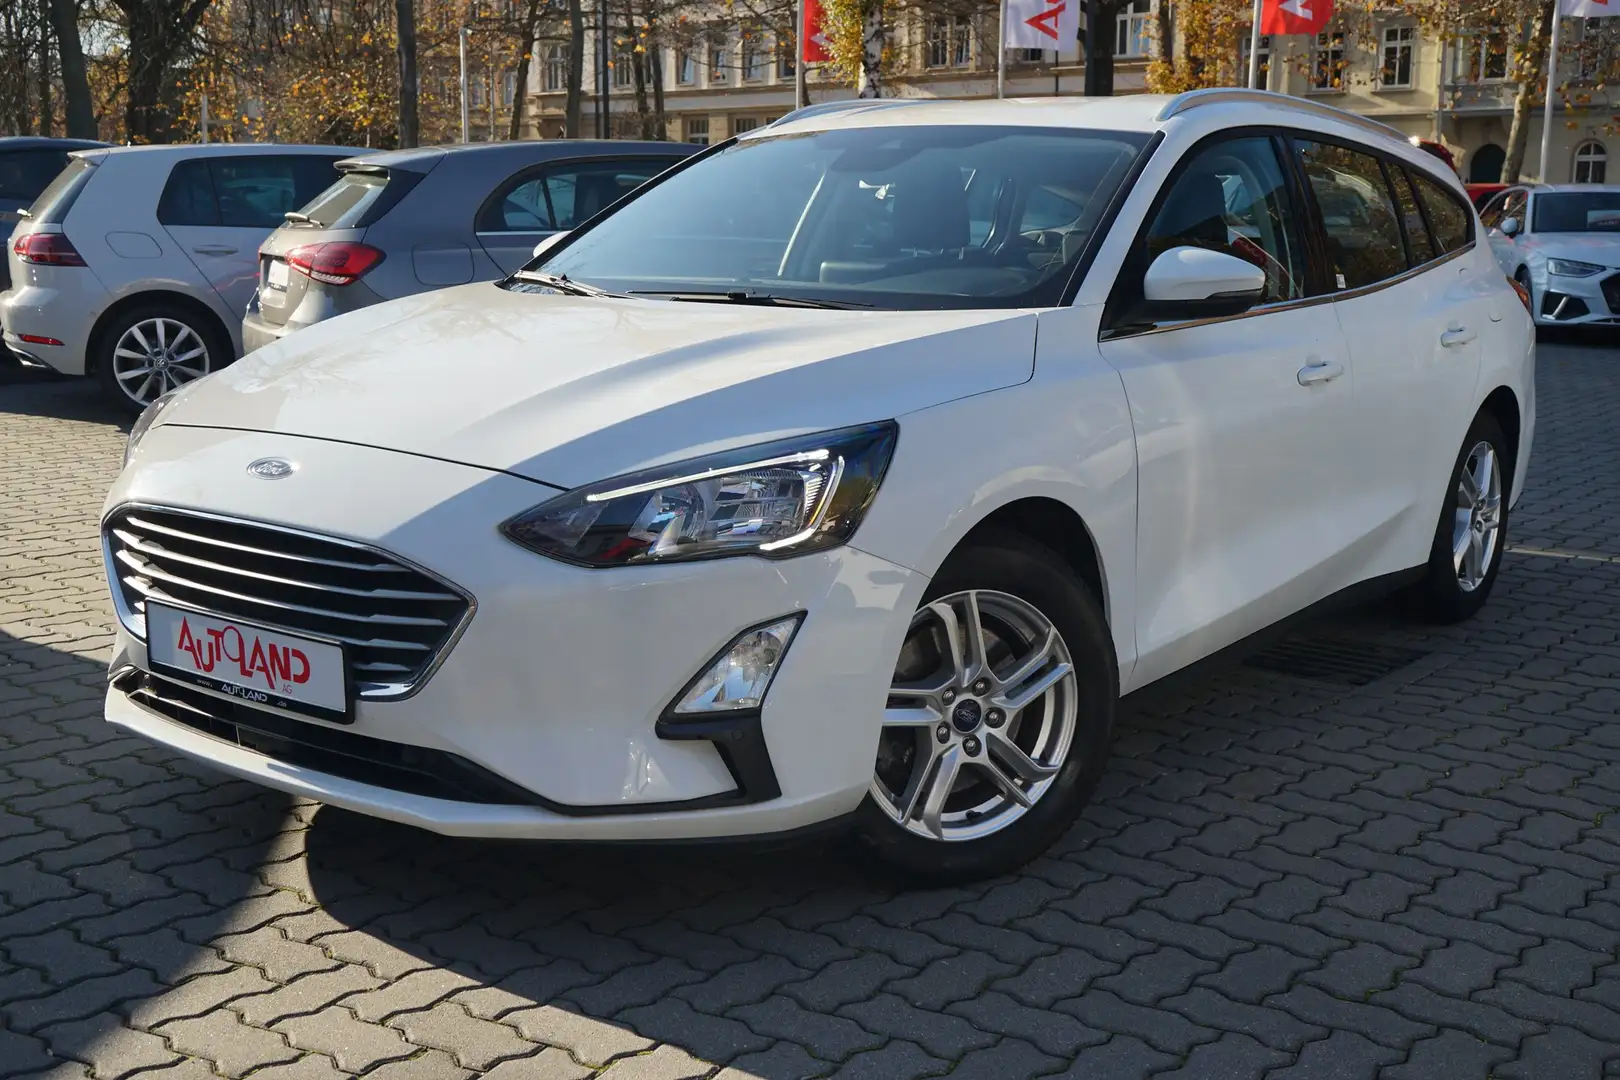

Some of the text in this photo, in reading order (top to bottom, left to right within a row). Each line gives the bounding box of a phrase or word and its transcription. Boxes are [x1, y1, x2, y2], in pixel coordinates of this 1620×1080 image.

[177, 616, 311, 690] AUTOLAND
[221, 683, 268, 702] AUTOLAND
[282, 684, 292, 695] AG
